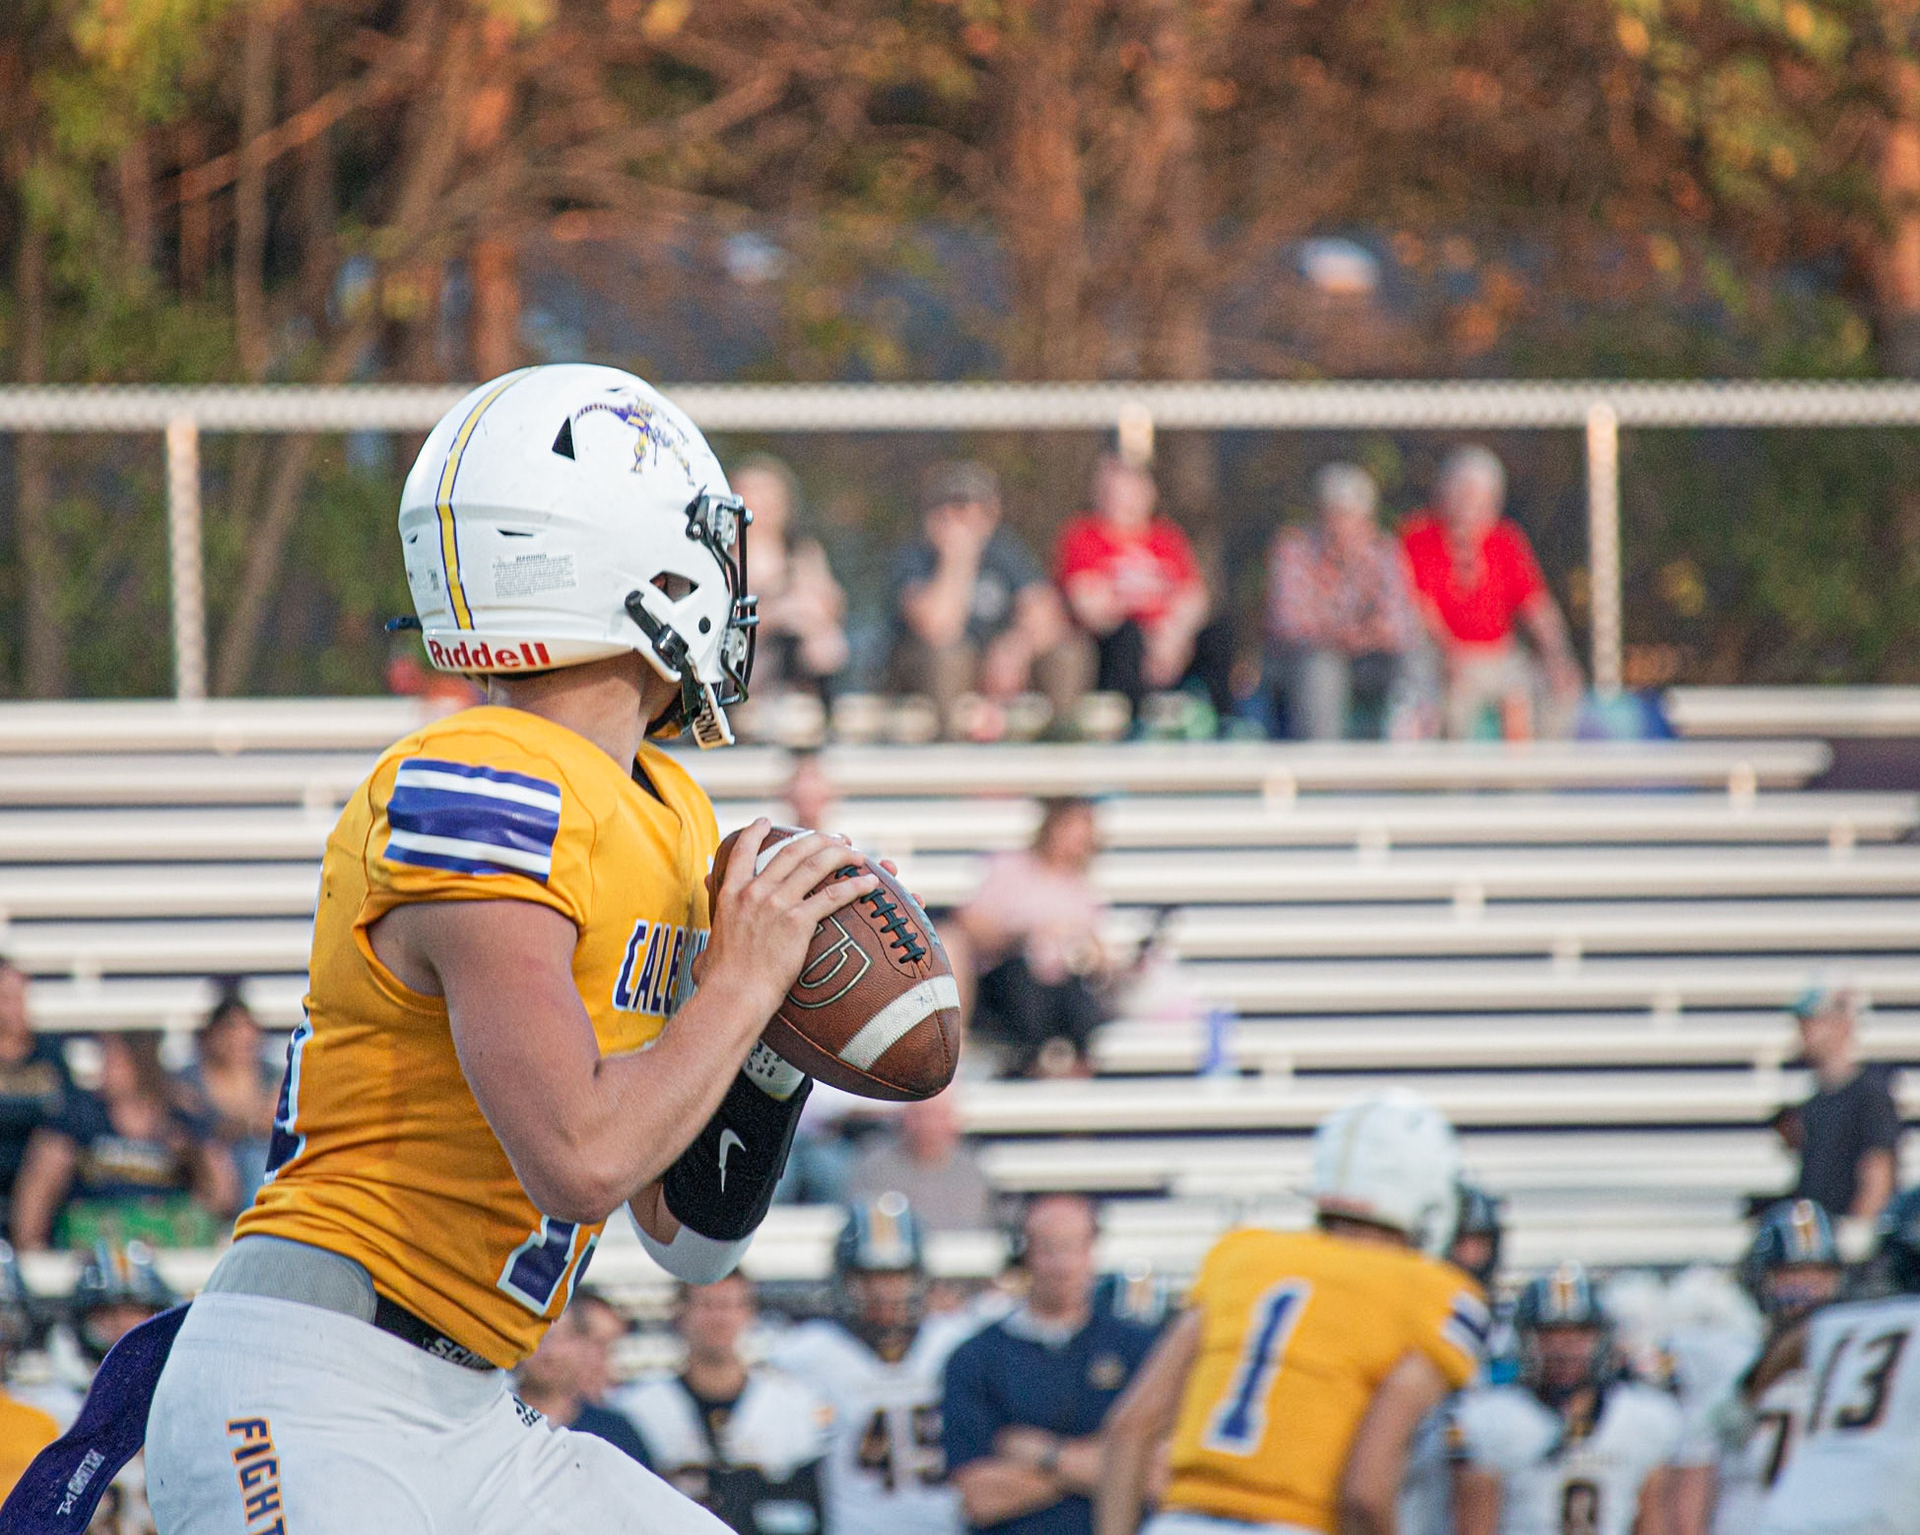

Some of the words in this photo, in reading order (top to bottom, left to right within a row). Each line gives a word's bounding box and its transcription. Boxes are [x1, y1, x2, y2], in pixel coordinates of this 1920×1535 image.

[428, 639, 551, 667] Riddell
[1200, 1275, 1314, 1456] 1
[1805, 1327, 1909, 1435] 13
